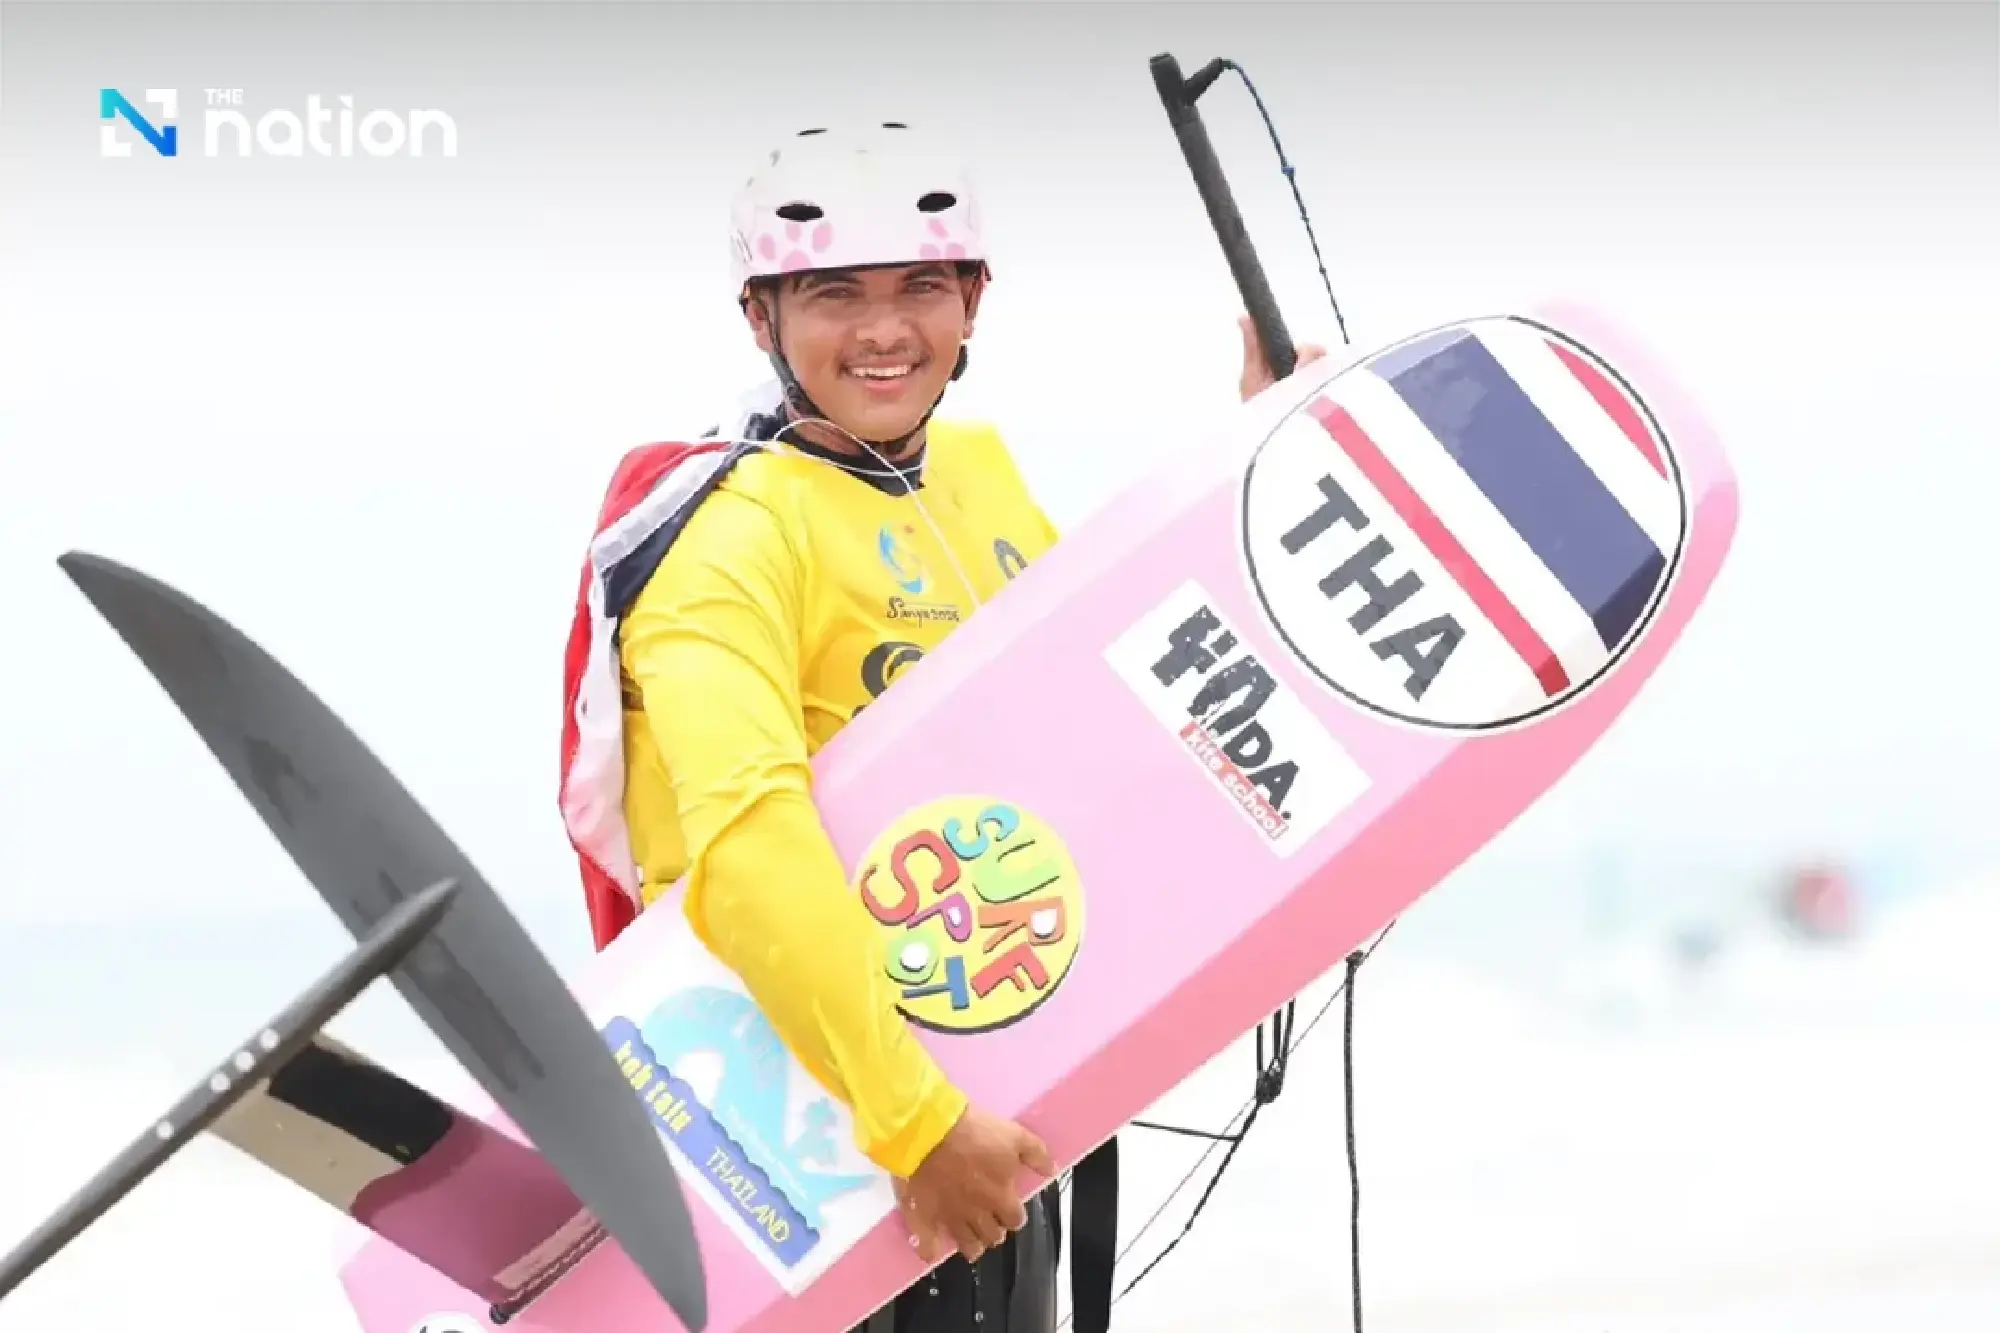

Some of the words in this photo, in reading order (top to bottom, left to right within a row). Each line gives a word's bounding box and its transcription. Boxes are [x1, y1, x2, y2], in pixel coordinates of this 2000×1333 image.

[1280, 472, 1467, 703] THA
[1223, 772, 1289, 840] school
[861, 829, 973, 1011] SPOT
[942, 804, 1067, 999] SURF
[706, 1145, 790, 1243] THAILAND
